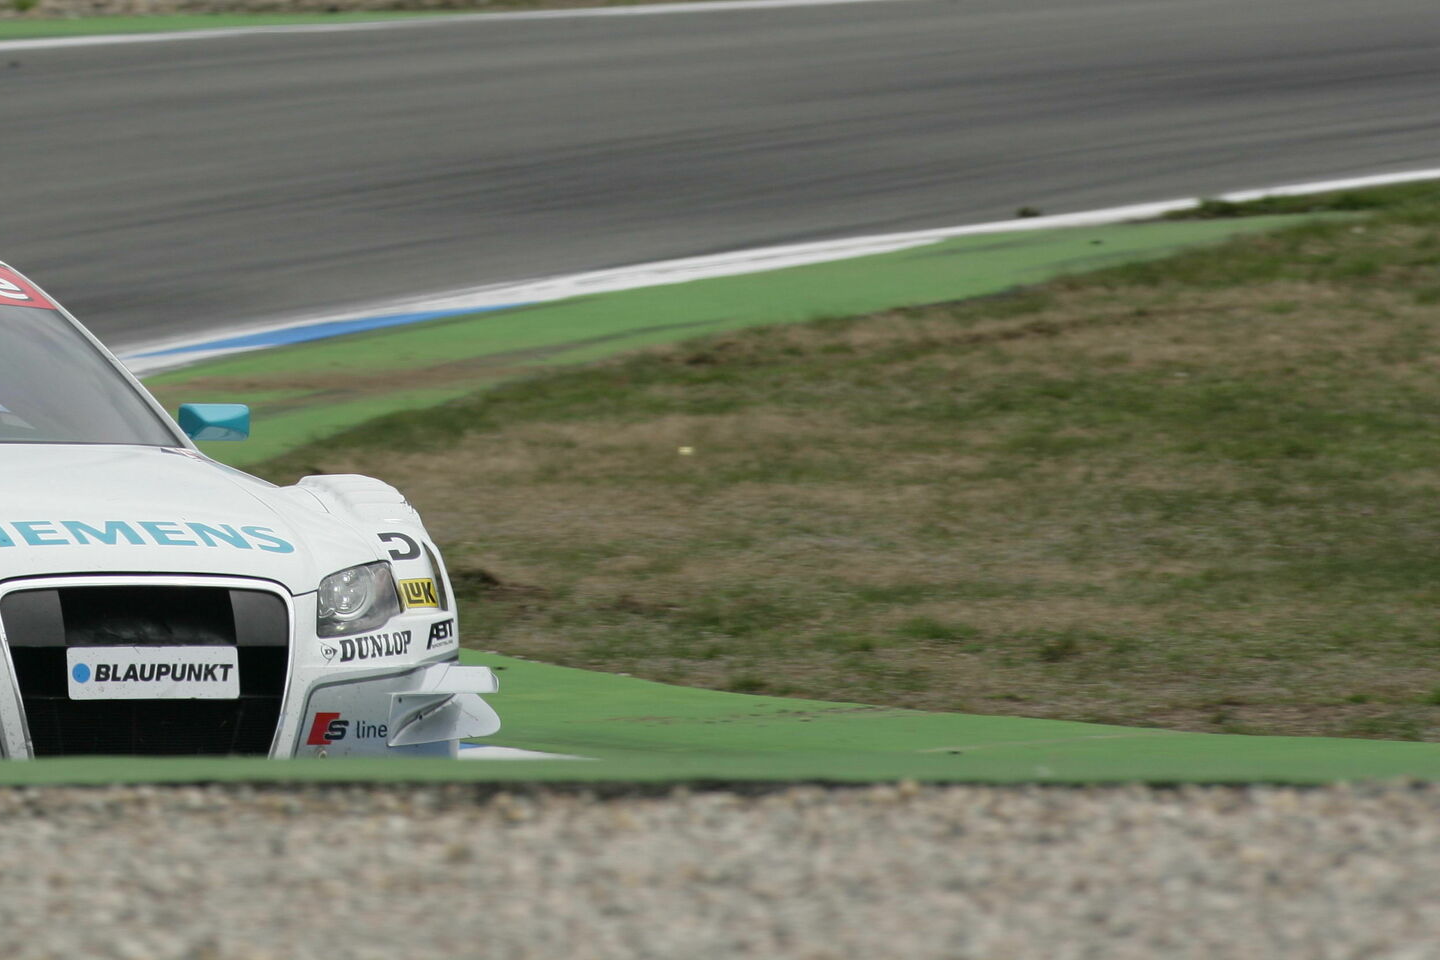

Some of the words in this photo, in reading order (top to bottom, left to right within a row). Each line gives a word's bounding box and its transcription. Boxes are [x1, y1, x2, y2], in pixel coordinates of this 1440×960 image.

[339, 630, 412, 662] DUNLOP
[426, 618, 454, 650] ABT
[95, 664, 233, 682] BLAUPUNKT
[324, 720, 349, 740] S
[356, 723, 388, 739] line
